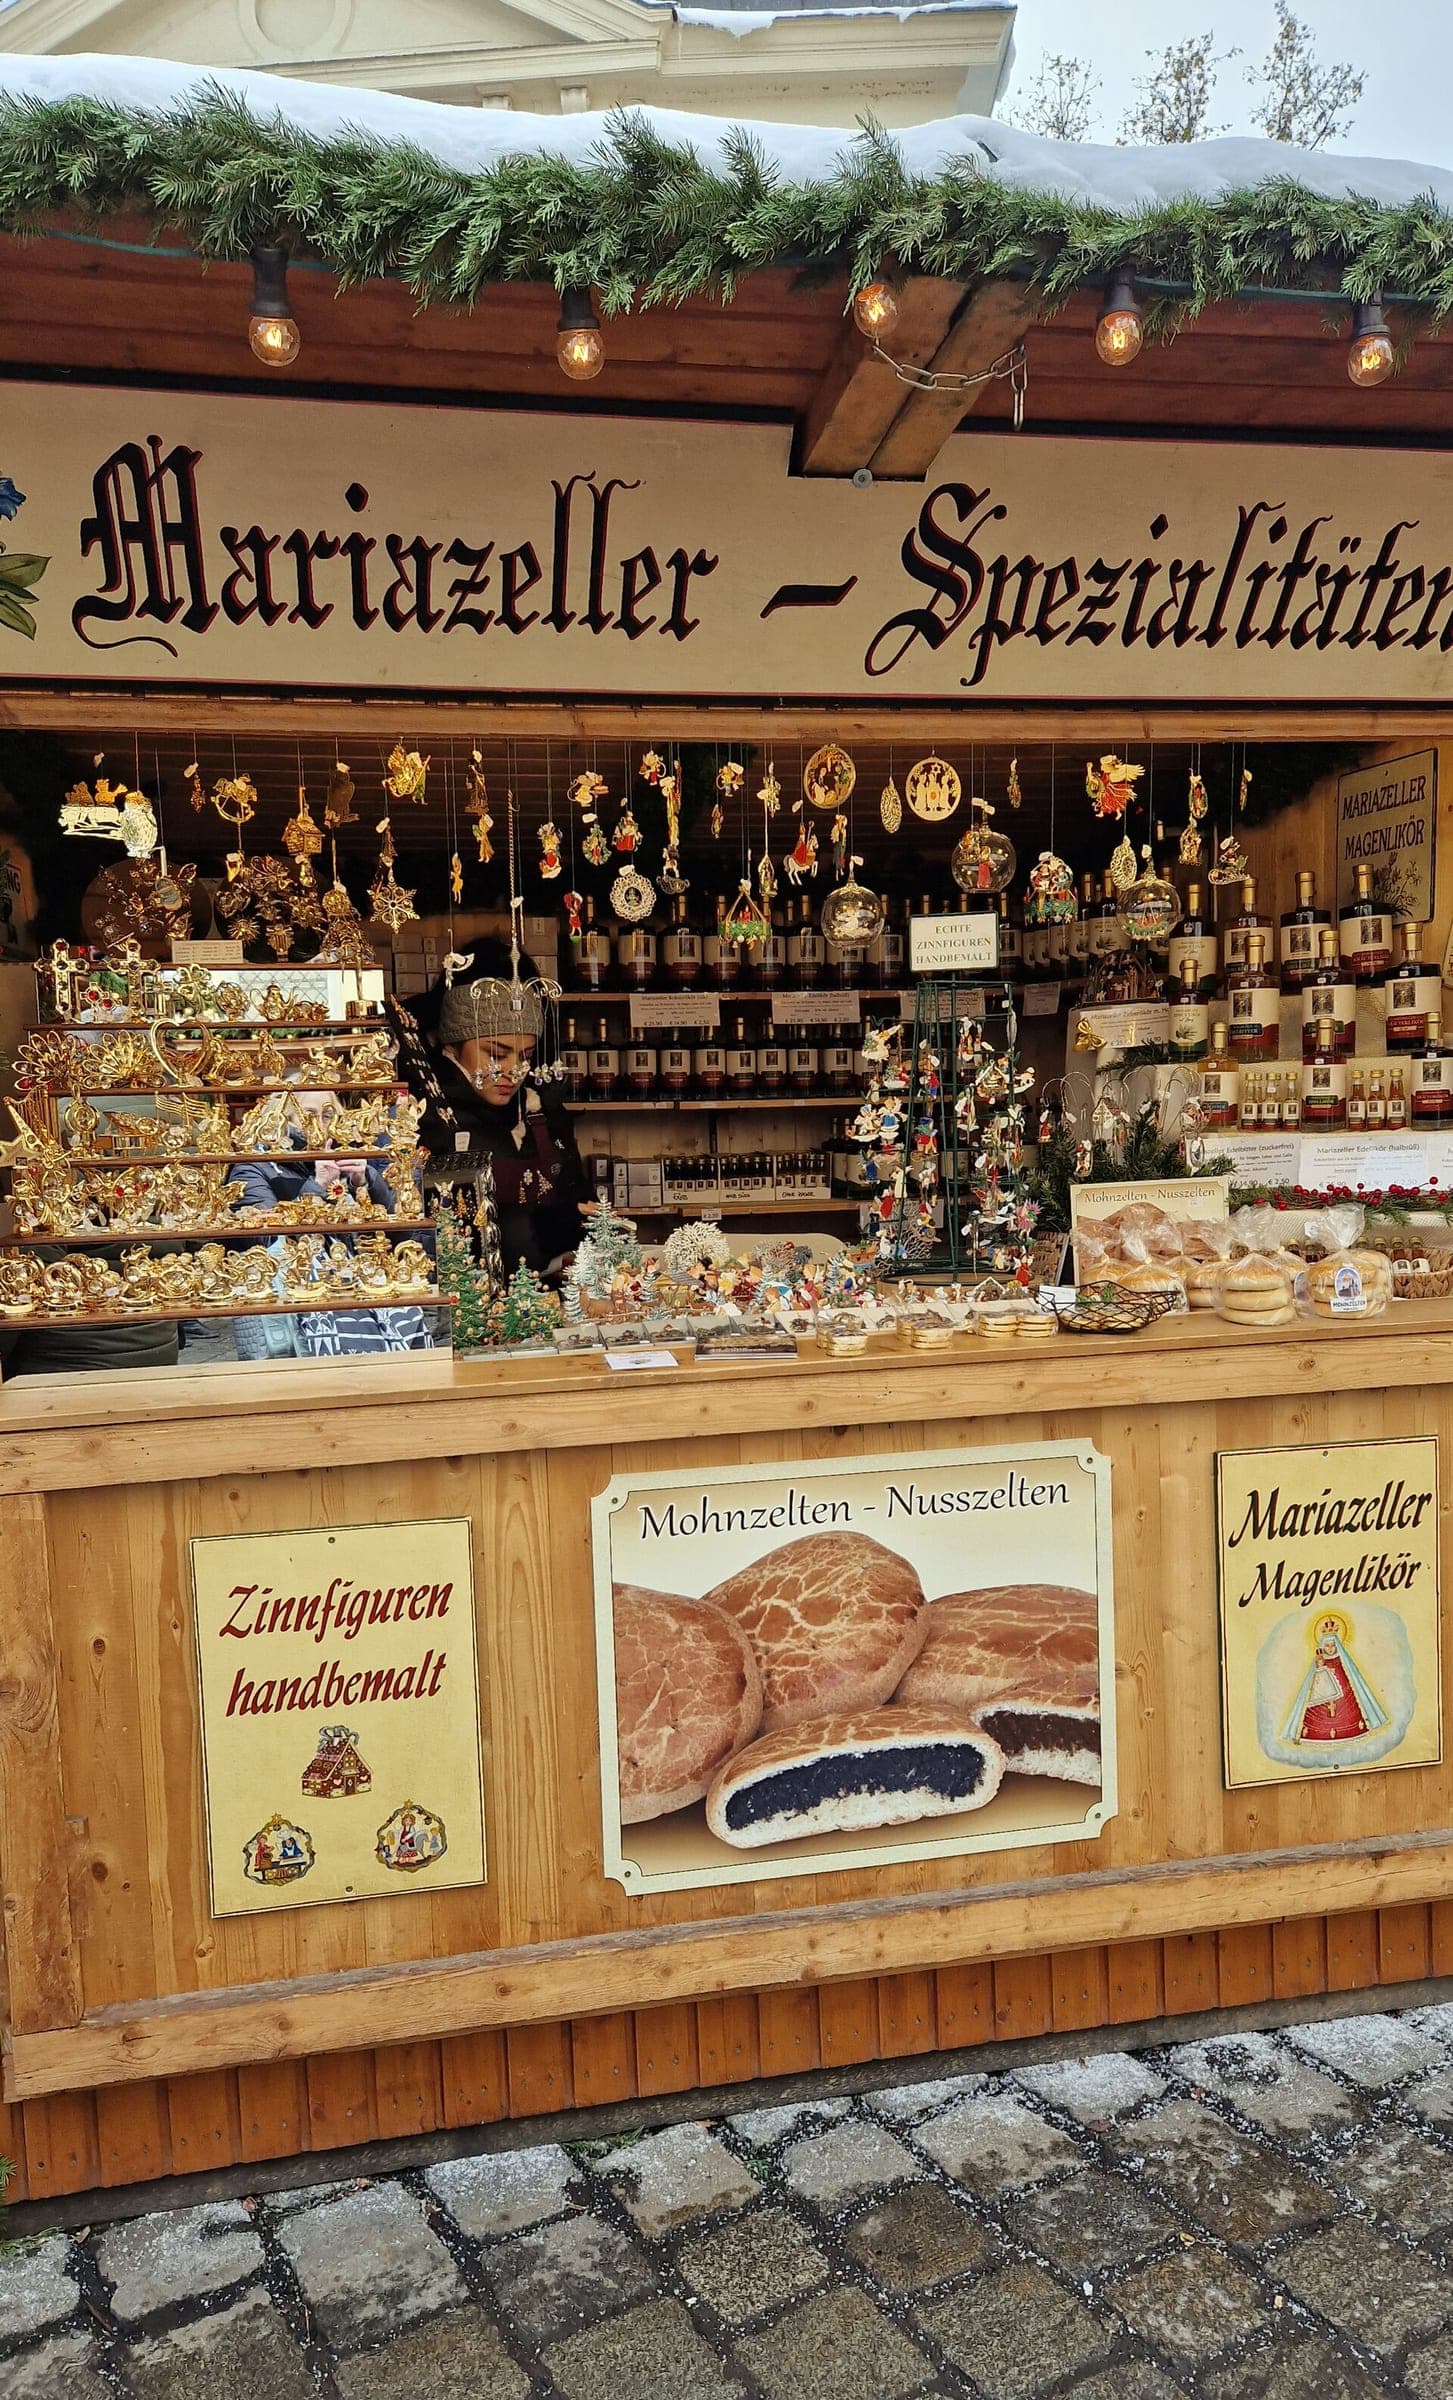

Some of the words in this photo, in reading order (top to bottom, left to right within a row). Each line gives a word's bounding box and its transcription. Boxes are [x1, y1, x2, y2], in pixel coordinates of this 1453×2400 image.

[72, 434, 720, 658] Mariazeller
[1342, 775, 1427, 820] MARIAZELLER
[1344, 816, 1426, 860] MAGENLIKÖR
[916, 937, 992, 950] ZINNFIGUREN
[935, 924, 973, 934] ECHTE
[916, 952, 993, 964] HANDBEMALT
[1259, 1143, 1295, 1152] (zuckerfrei)
[1317, 1146, 1355, 1154] Mariazeller
[1085, 1190, 1147, 1203] Mohnzelten
[1157, 1186, 1215, 1199] Nusszelten
[640, 1489, 852, 1540] Mohnzelten
[887, 1472, 1070, 1519] Nusszelten
[1228, 1480, 1432, 1548] Mariazeller
[1238, 1552, 1421, 1608] Magenlikör
[219, 1578, 454, 1643] Zinnfiguren
[226, 1649, 447, 1717] handbemalt
